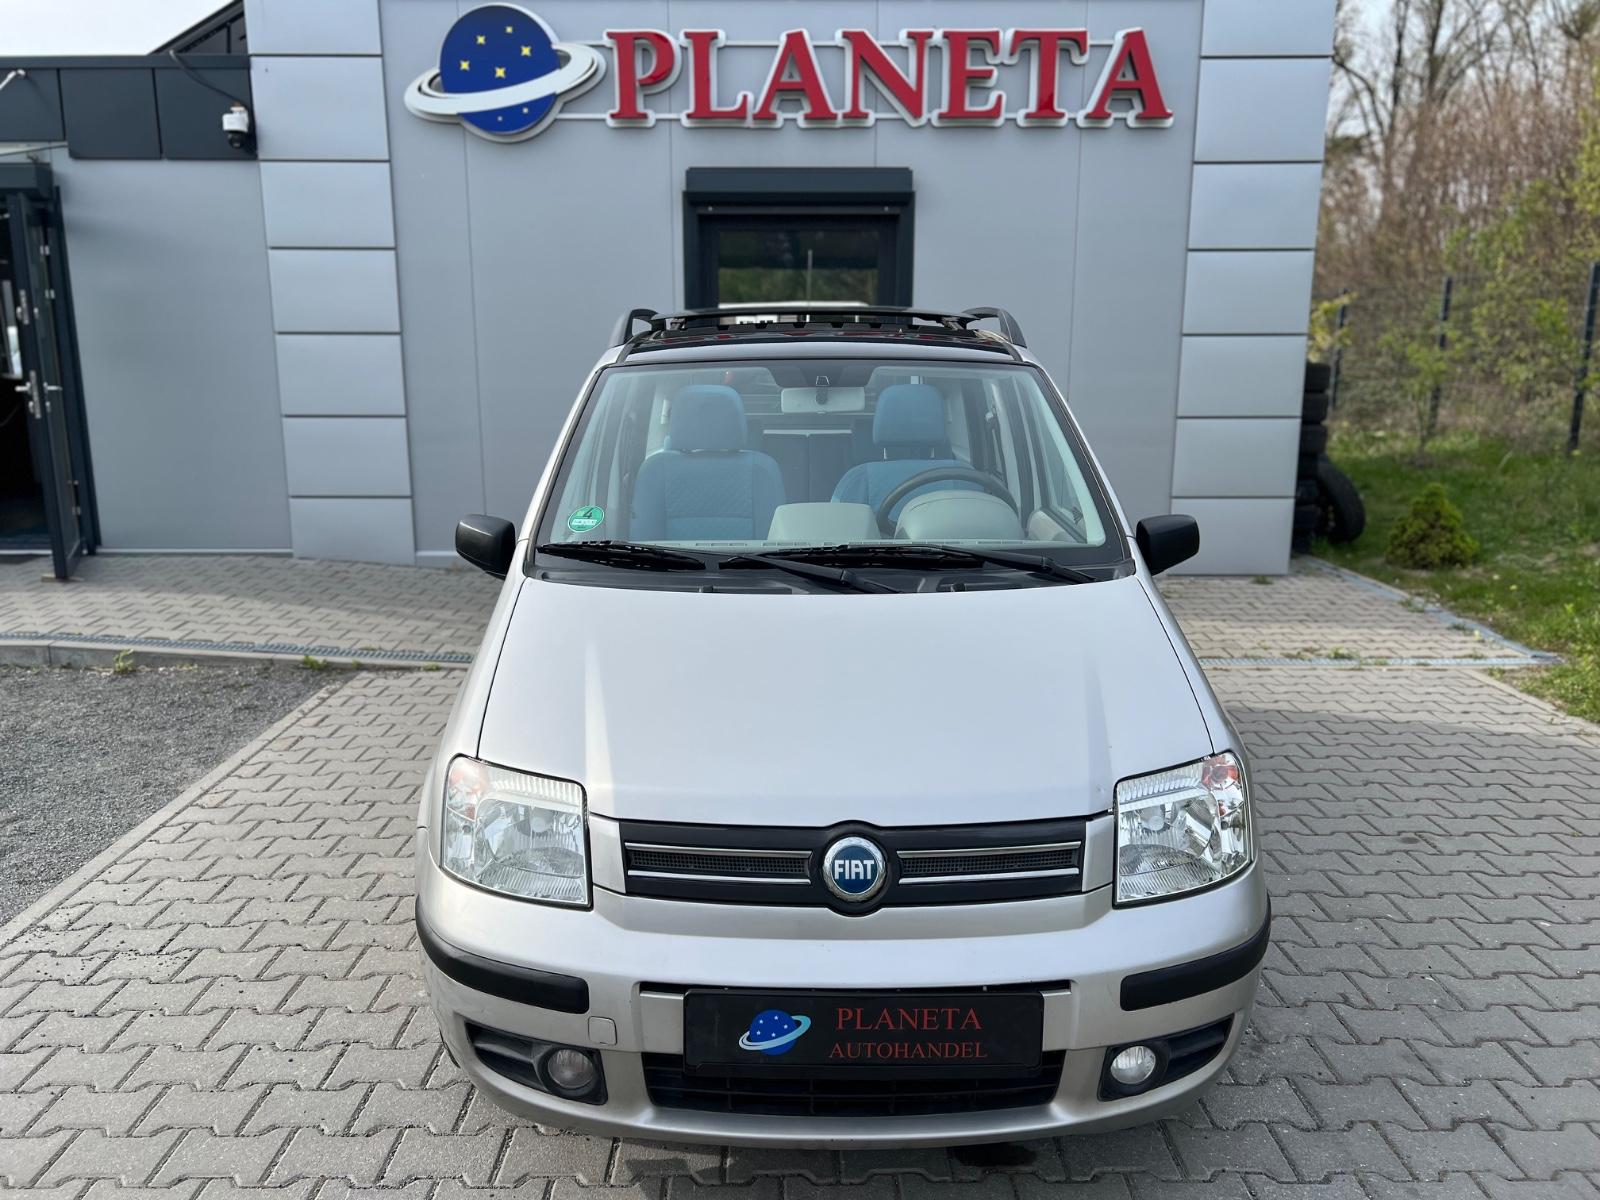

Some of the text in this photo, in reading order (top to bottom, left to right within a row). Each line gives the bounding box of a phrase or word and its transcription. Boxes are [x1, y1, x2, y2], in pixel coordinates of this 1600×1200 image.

[604, 28, 1174, 125] PLANETA
[582, 507, 594, 519] 4
[834, 859, 875, 880] FIAT
[835, 1007, 983, 1030] PLANETA
[828, 1042, 988, 1059] AUTOHANDEL
